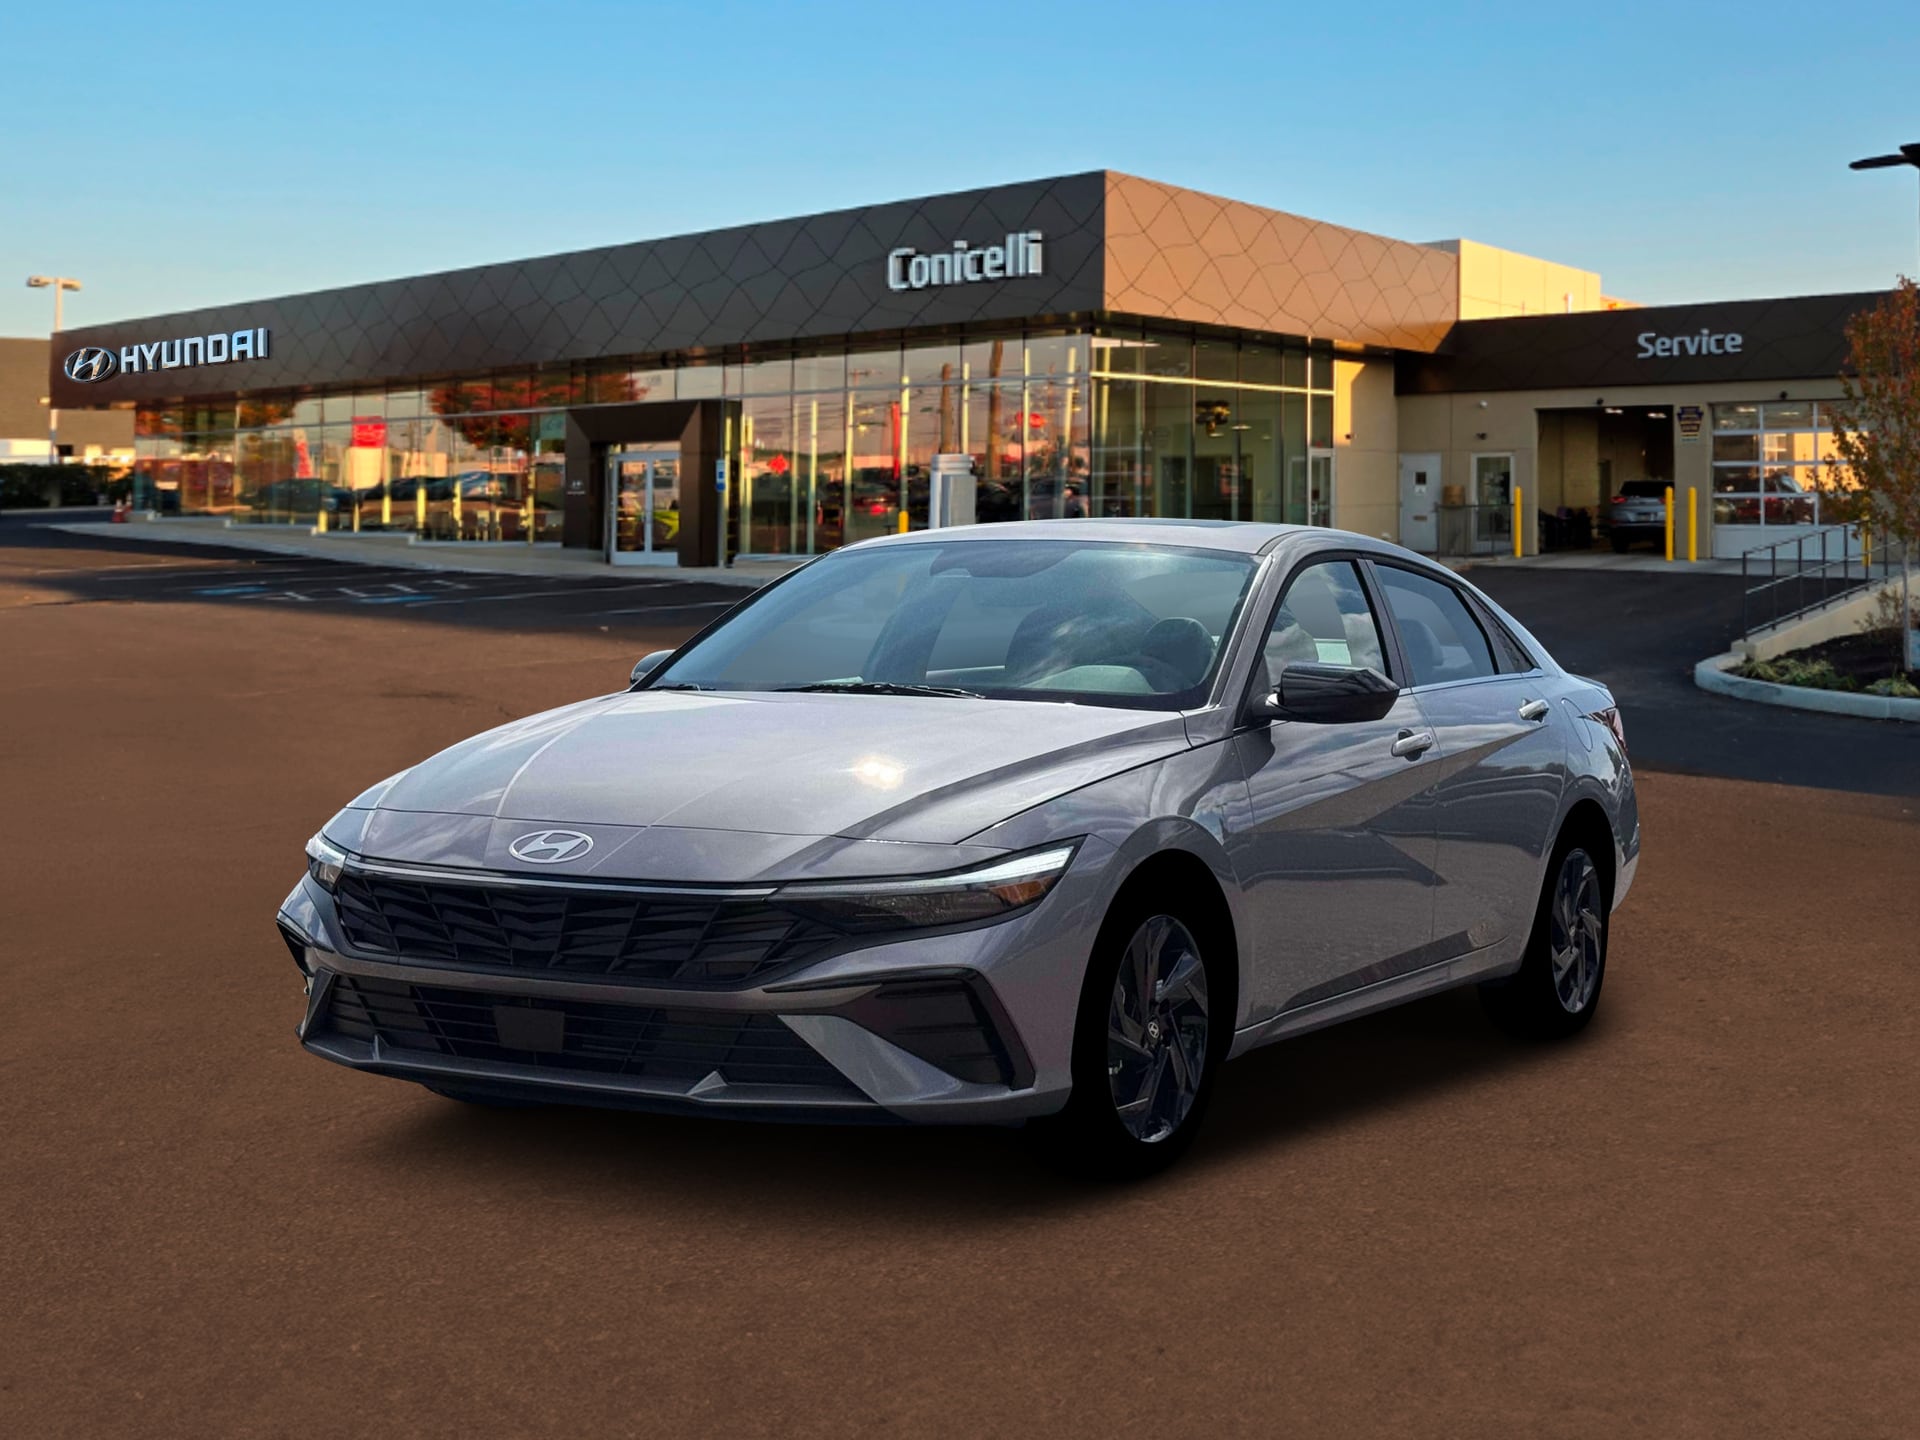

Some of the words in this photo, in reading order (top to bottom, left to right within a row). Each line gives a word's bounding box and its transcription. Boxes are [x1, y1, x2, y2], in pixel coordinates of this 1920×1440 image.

[888, 230, 1043, 290] Conicelli
[120, 327, 267, 373] HYUNDAI
[1637, 328, 1742, 358] Service
